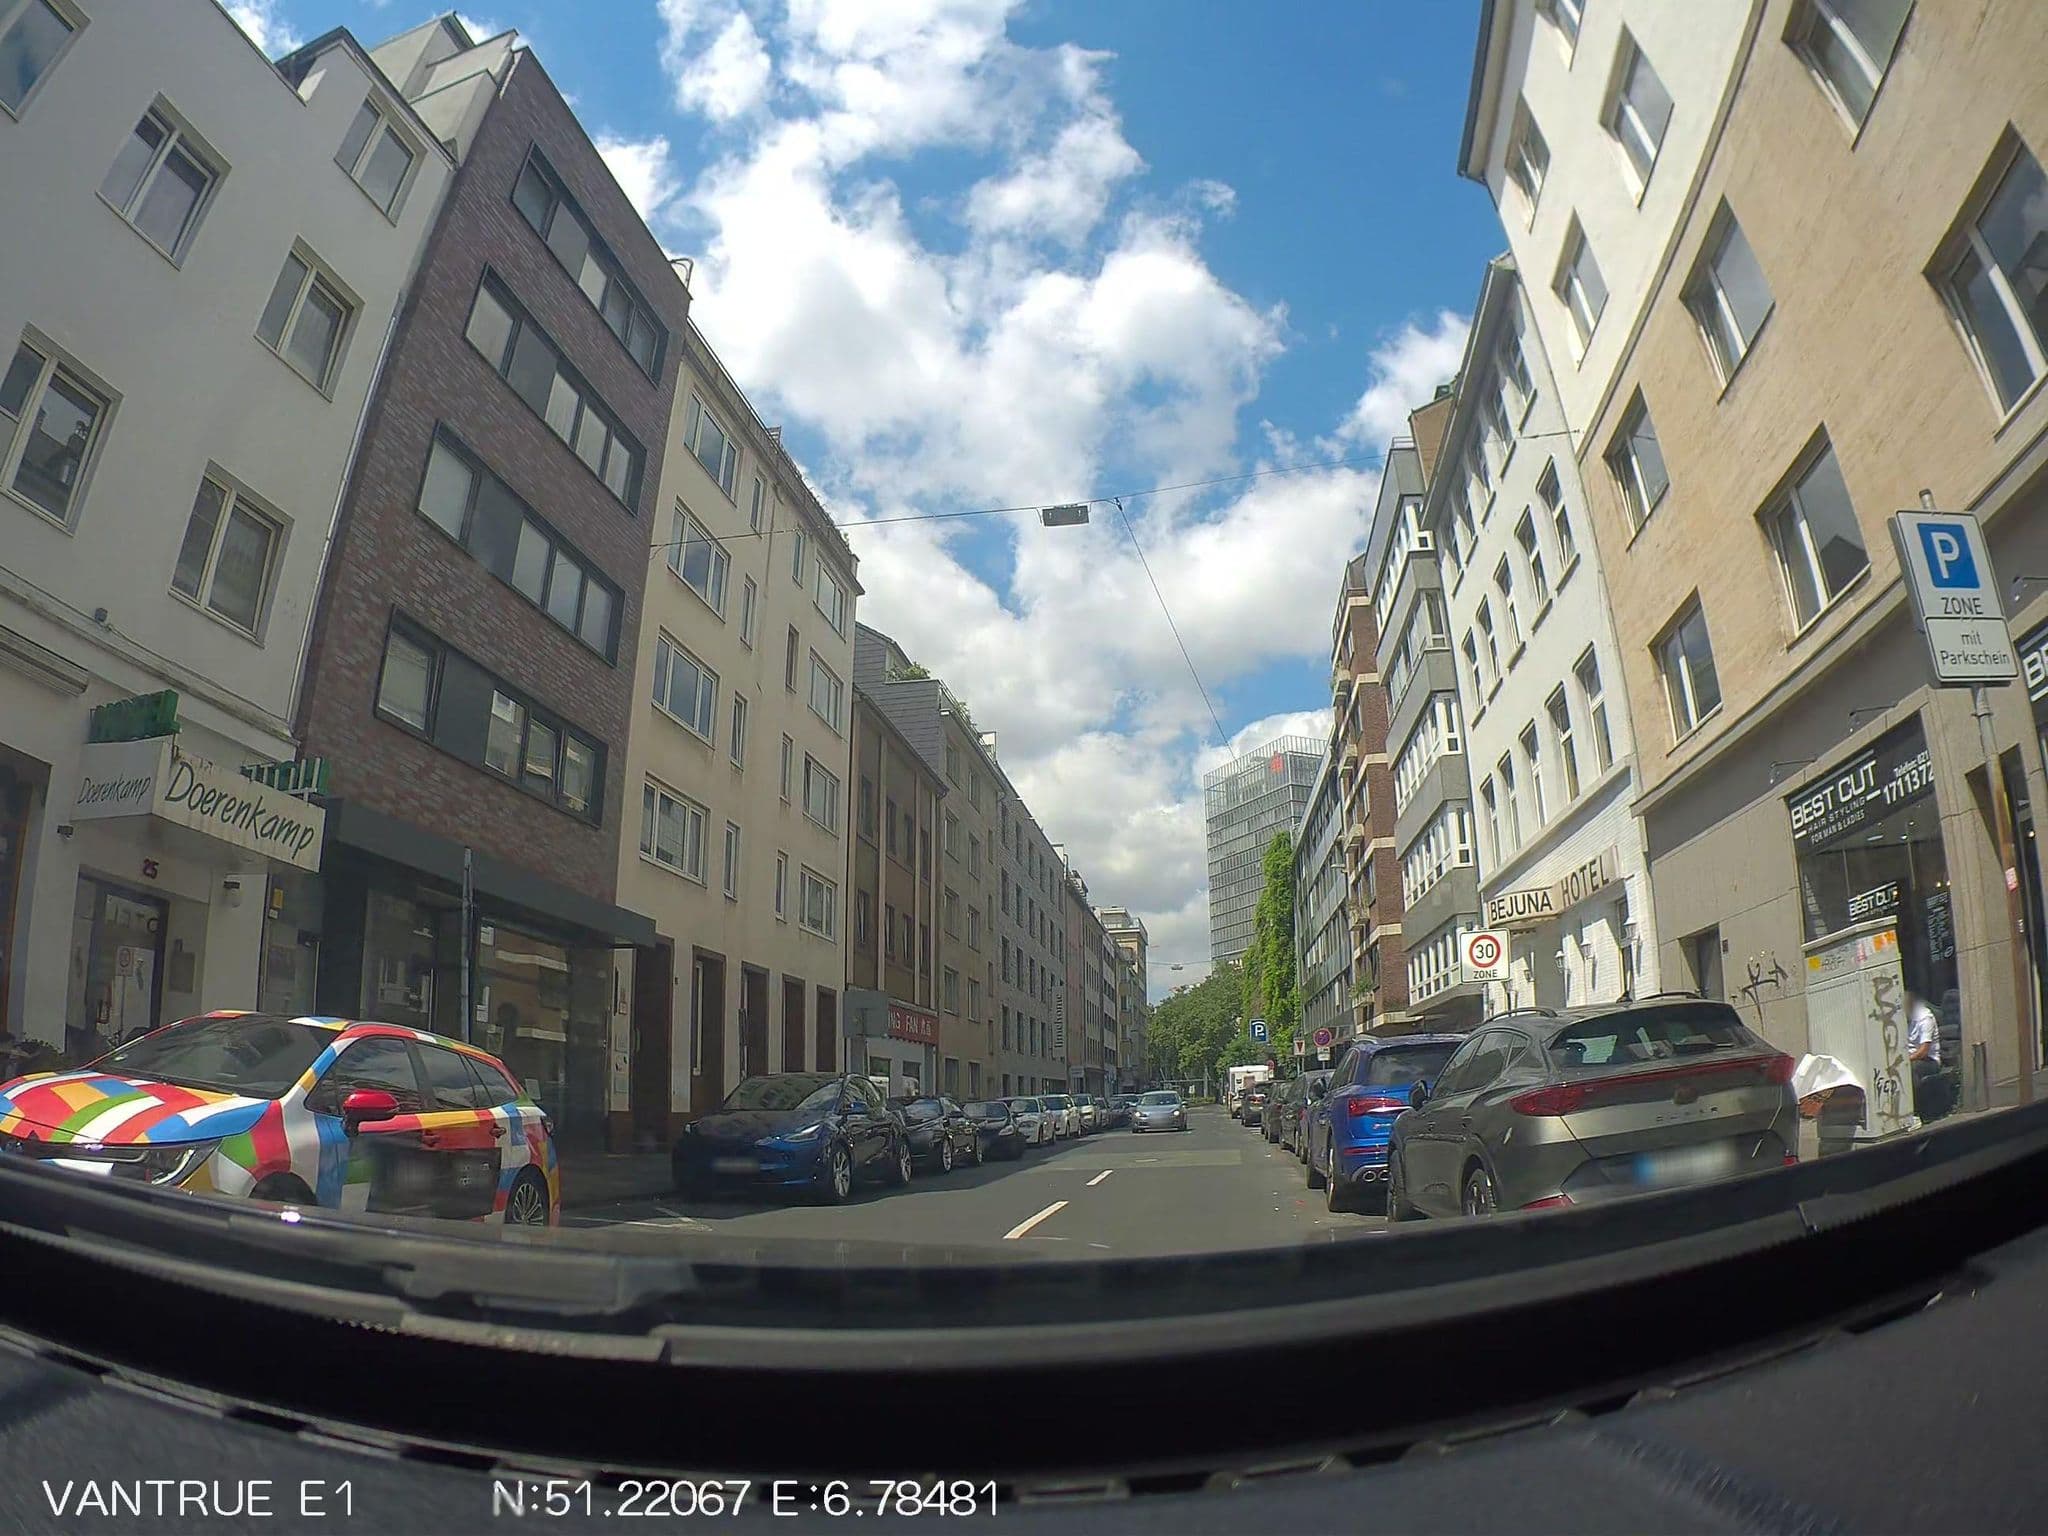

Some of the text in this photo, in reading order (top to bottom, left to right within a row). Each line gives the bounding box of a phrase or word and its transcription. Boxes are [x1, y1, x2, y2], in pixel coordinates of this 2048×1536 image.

[1930, 532, 1960, 579] P
[1941, 597, 1984, 615] ZONE
[1960, 631, 1983, 645] mit
[1940, 650, 2010, 665] Parkschein
[77, 774, 151, 805] Doerenkamp
[1792, 760, 1876, 830] BEST CUT
[1883, 762, 1935, 804] 1711372
[164, 761, 314, 859] Doerenkamp
[1808, 796, 1866, 834] HAIR STYLING
[143, 858, 158, 879] 25
[1490, 855, 1610, 921] BEJUNA HOTEL
[1850, 895, 1874, 916] BEST
[1475, 943, 1494, 959] 30
[1473, 969, 1498, 979] ZONE
